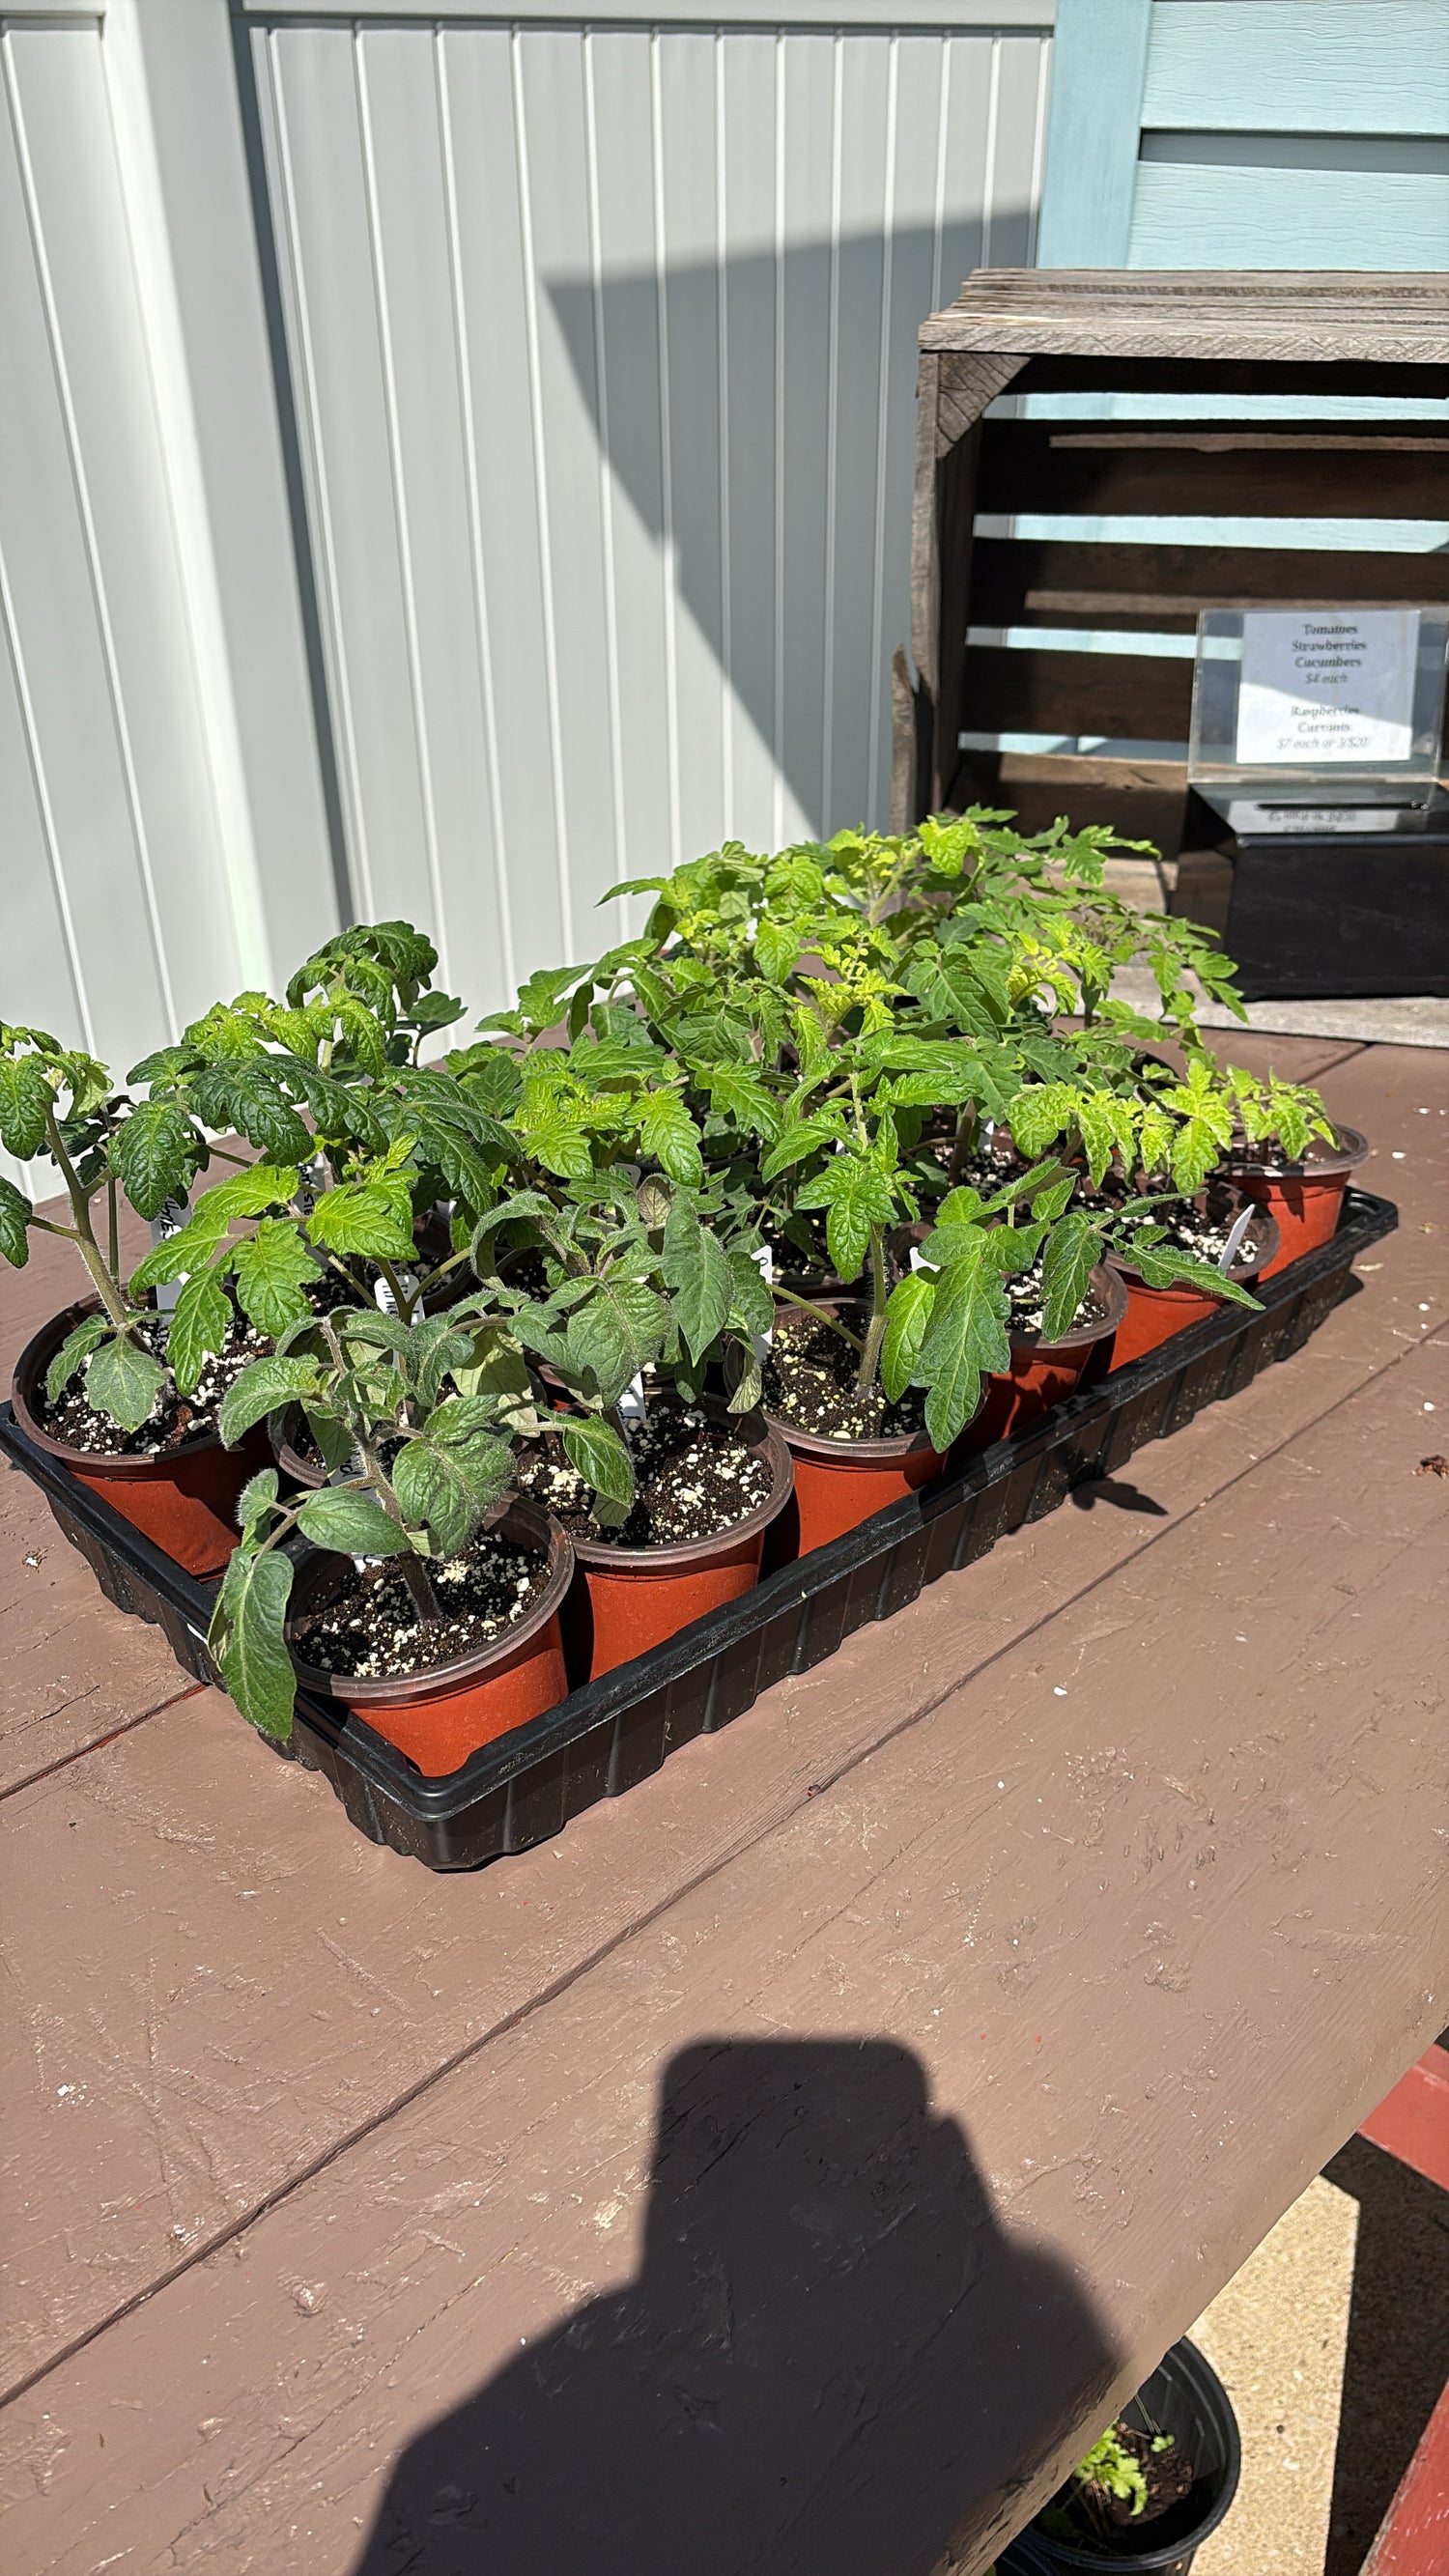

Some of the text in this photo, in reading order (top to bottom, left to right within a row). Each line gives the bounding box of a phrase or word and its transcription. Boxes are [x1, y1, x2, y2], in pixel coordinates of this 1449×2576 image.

[1303, 624, 1359, 635] Tomatoes
[1292, 639, 1368, 652] Strawberries
[1294, 656, 1362, 668] Cucumbers
[1321, 672, 1349, 684] each
[1291, 704, 1360, 718] Raspberries
[1297, 721, 1351, 733] Currants
[1293, 736, 1320, 749] each
